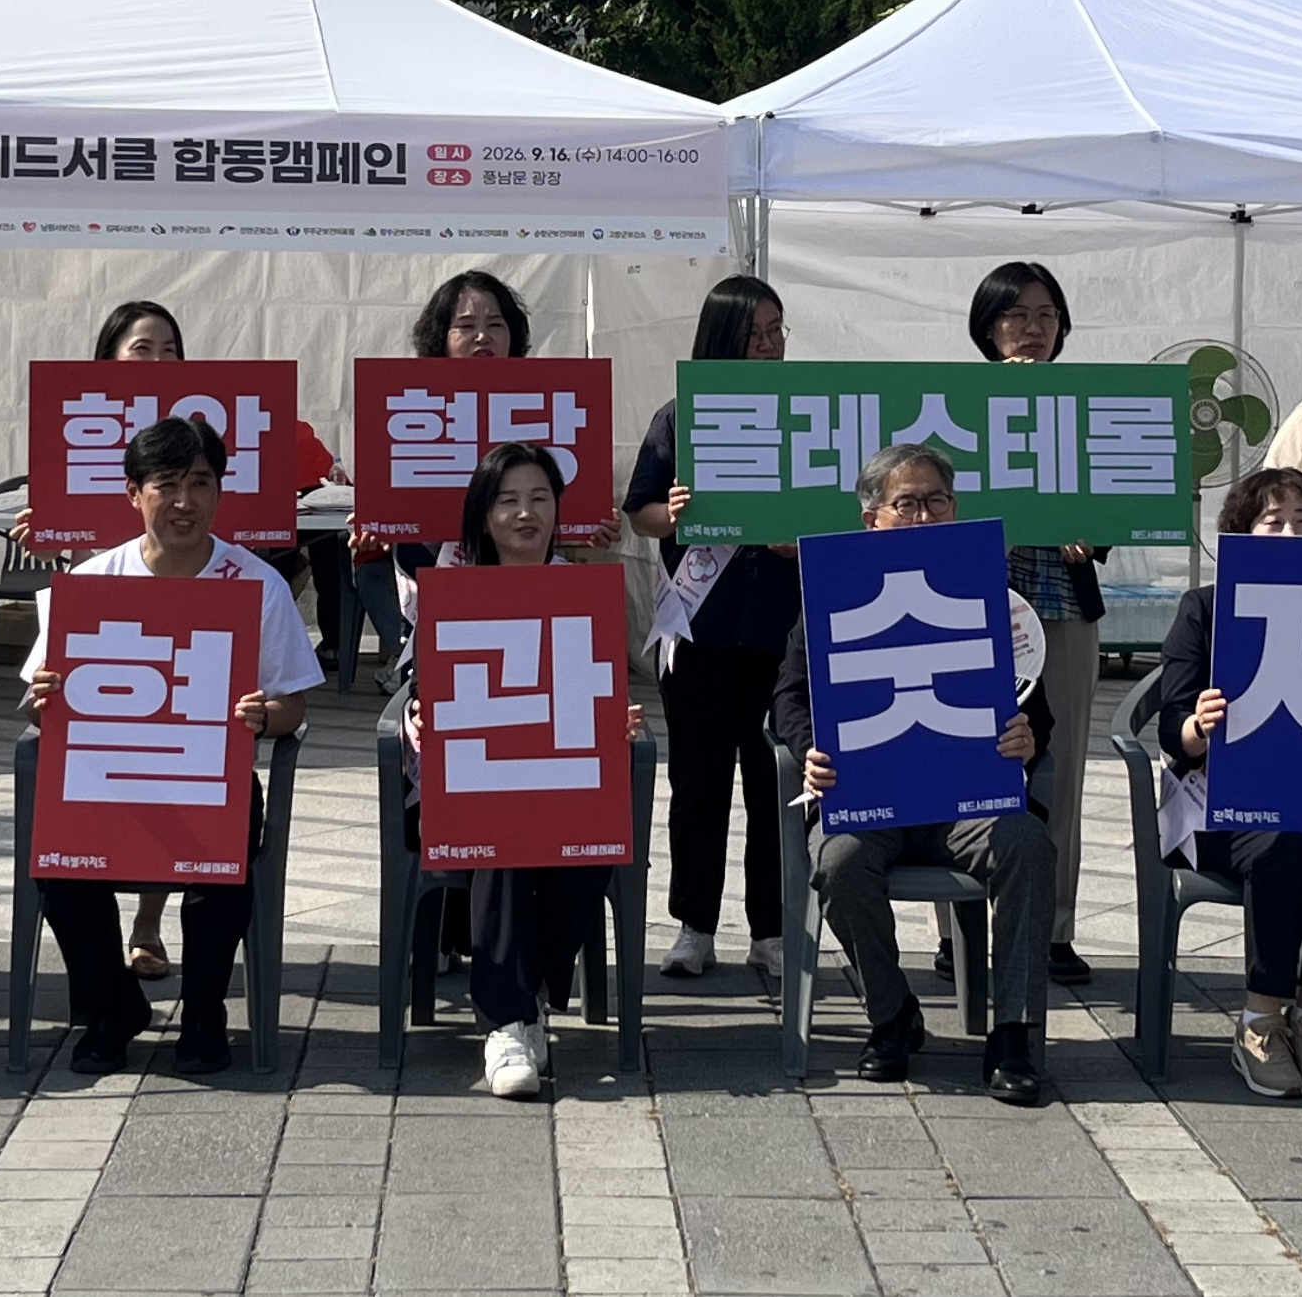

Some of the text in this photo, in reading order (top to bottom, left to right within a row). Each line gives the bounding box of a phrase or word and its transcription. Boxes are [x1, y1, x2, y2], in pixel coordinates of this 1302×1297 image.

[173, 137, 408, 186] 합동캠페인
[482, 146, 527, 162] 2026.
[550, 148, 571, 163] 16.
[575, 147, 602, 163] (수)
[482, 169, 561, 186] 풍남문 광장
[690, 393, 1176, 495] 콜레스테롤
[433, 616, 613, 793] 관
[828, 570, 996, 753] 숫
[63, 621, 233, 805] 혈
